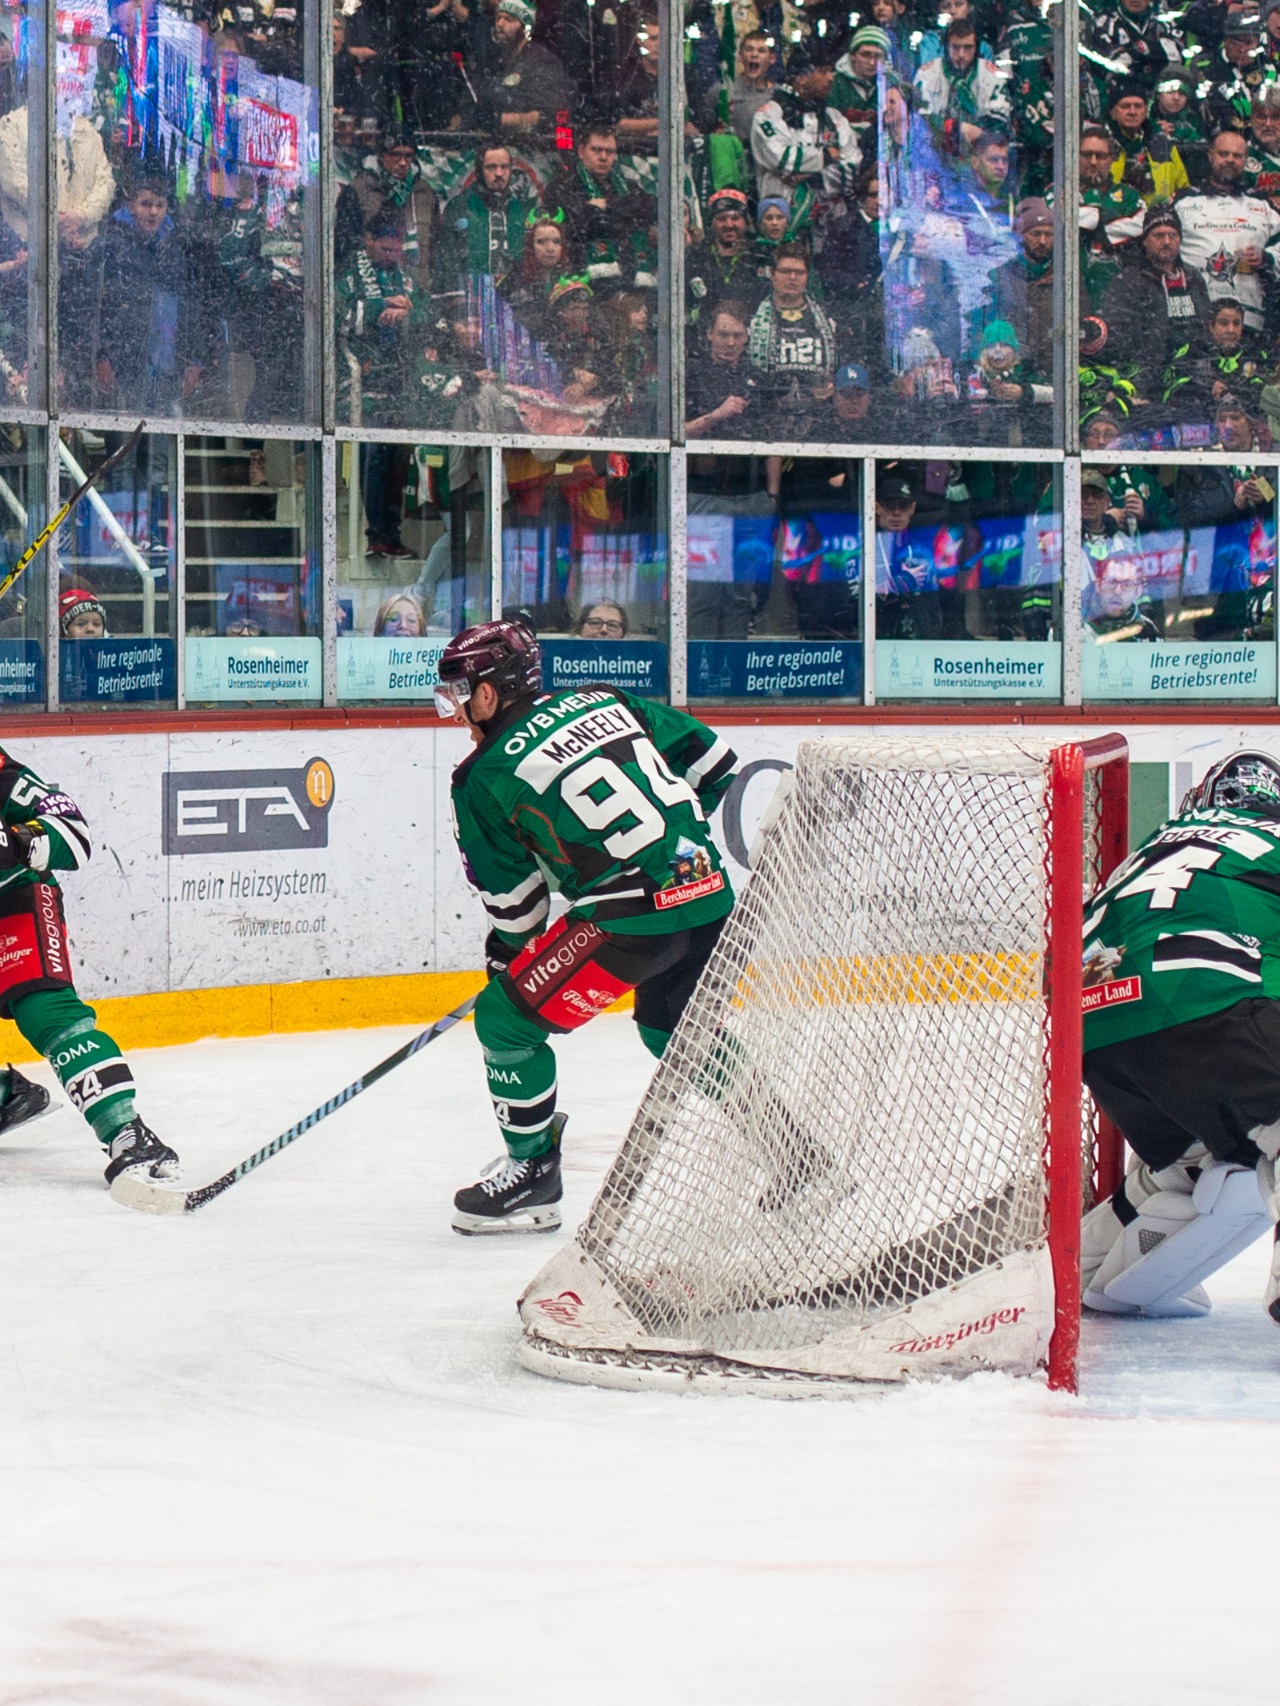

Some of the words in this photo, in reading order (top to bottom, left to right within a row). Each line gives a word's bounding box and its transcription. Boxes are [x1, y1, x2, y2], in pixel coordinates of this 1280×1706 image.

[97, 650, 118, 669] Ihre
[119, 644, 163, 670] regionale
[228, 656, 309, 674] Rosenheimer
[389, 648, 413, 665] Ihre
[553, 656, 652, 675] Rosenheimer
[746, 651, 775, 669] Ihre
[778, 647, 843, 670] regionale
[934, 658, 1044, 675] Rosenheimer
[1150, 652, 1181, 669] Ihre
[1184, 647, 1256, 670] regionale
[98, 669, 164, 695] Betriebsrente!
[228, 678, 296, 690] Unterstützungskasse
[638, 677, 652, 687] e.V.
[747, 669, 844, 692] Betriebsrente!
[934, 678, 1027, 690] Unterstützungskasse
[1028, 678, 1045, 688] e.V.
[1150, 668, 1258, 691] Betriebsrente!
[553, 690, 616, 725] MEDIA
[541, 708, 633, 765] McNEELY
[560, 737, 706, 861] 94
[177, 786, 311, 836] ETA
[229, 868, 327, 903] Heizsystem
[40, 884, 64, 974] vitagroup
[239, 915, 327, 936] www.eta.co.at
[1104, 981, 1133, 1001] Land
